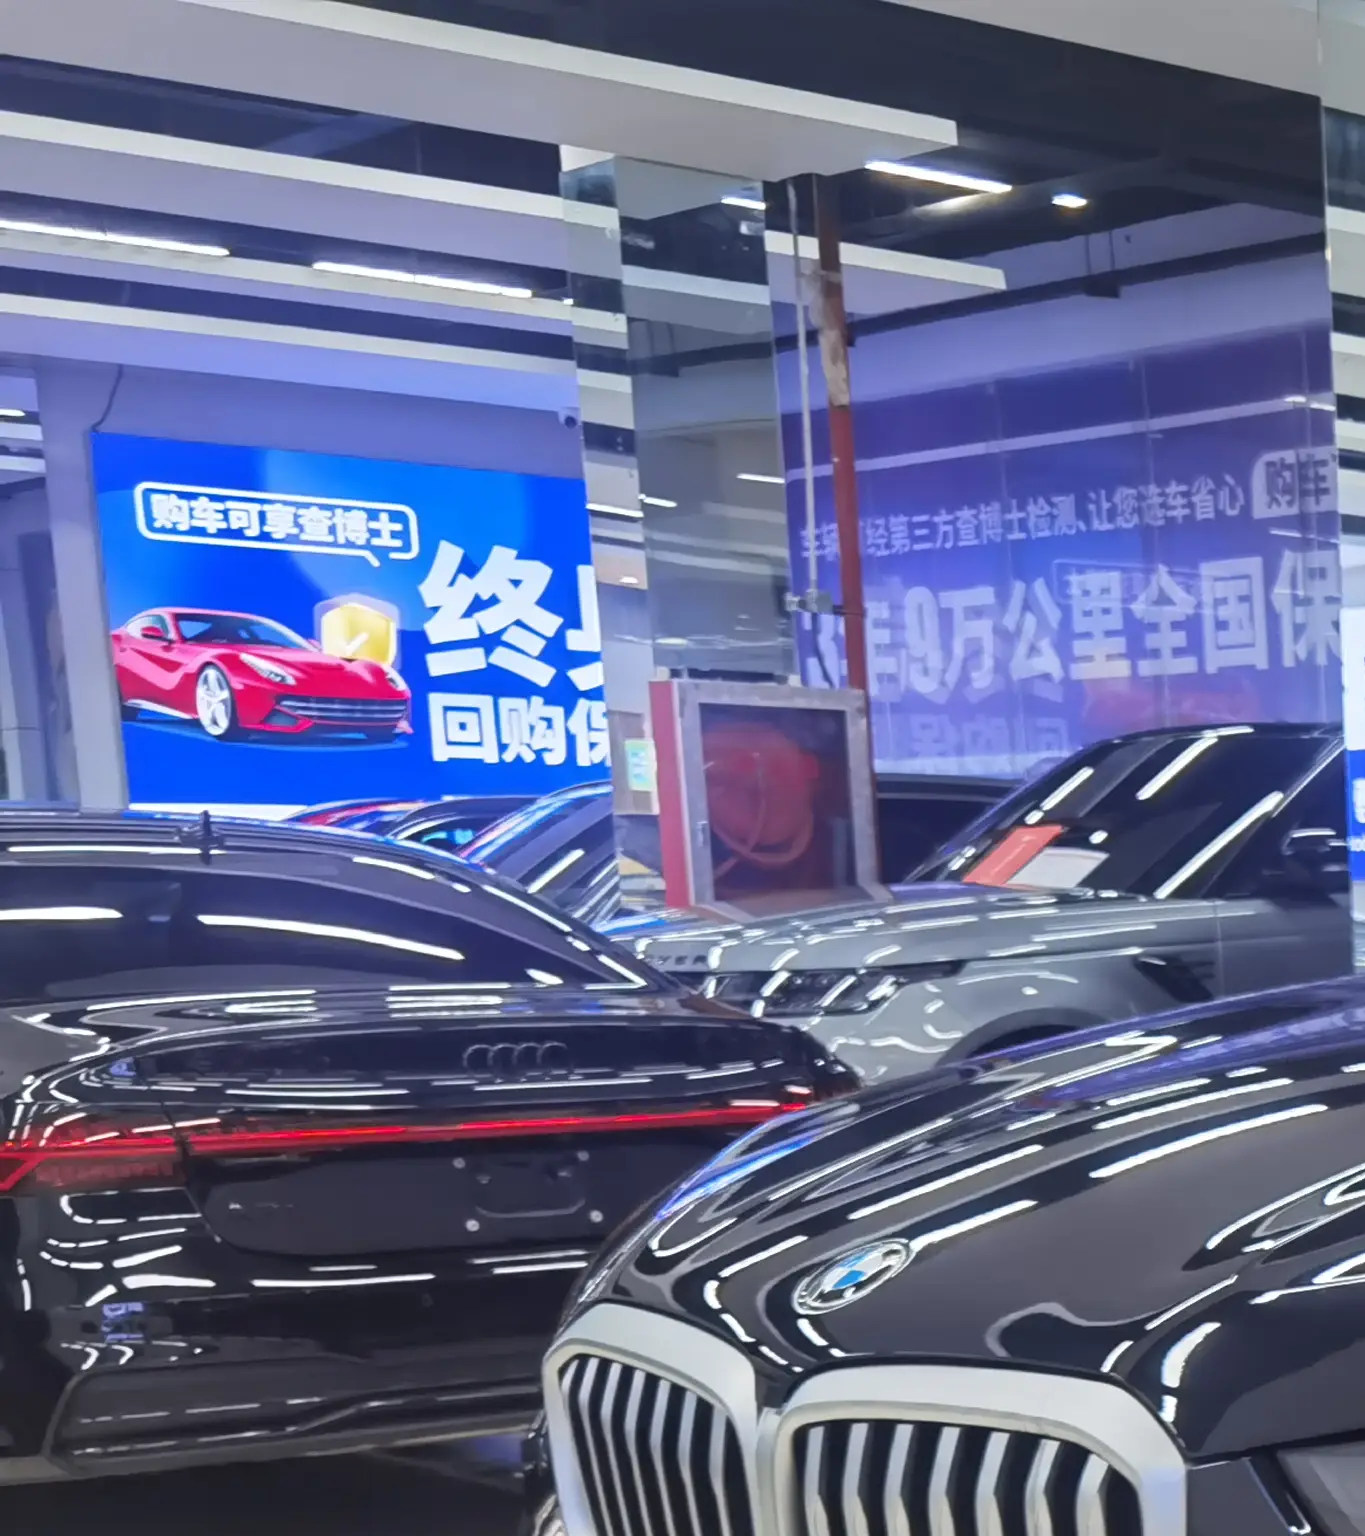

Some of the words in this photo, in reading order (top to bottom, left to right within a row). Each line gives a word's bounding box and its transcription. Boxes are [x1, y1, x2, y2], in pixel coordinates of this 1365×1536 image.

[1264, 453, 1337, 510] 购车
[151, 494, 403, 547] 购车可享查博士
